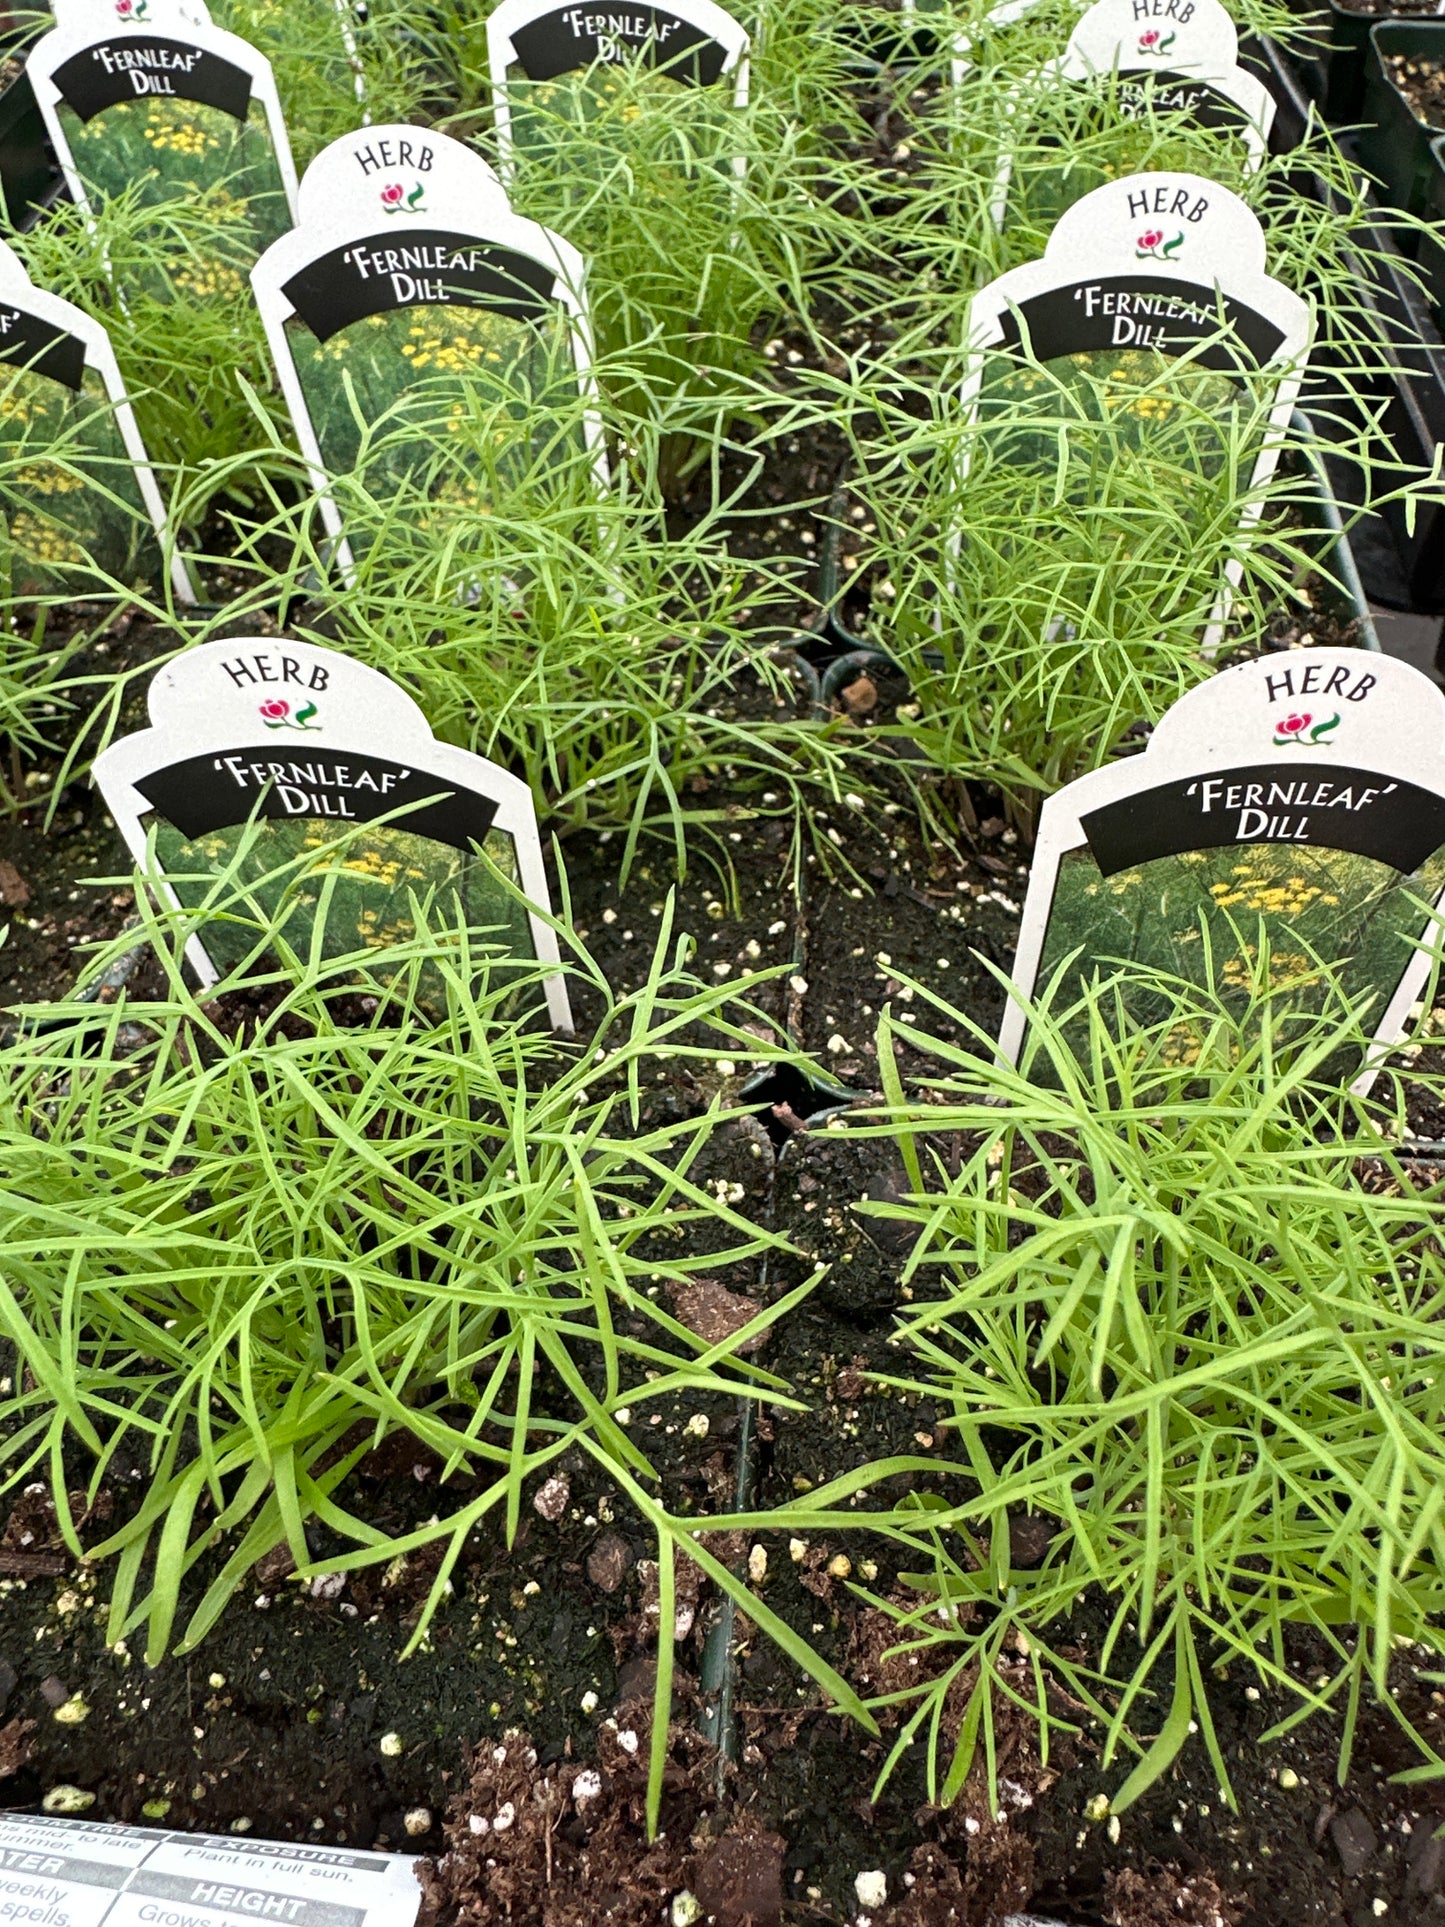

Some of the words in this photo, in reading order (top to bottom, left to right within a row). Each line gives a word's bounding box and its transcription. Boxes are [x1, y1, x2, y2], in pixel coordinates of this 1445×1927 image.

[1132, 0, 1195, 24] HERB
[93, 47, 202, 74] 'FERNLEAF'
[129, 70, 176, 95] DILL
[354, 140, 434, 176] HERB
[1127, 187, 1209, 223] HERB
[344, 246, 490, 279] 'FERNLEAF'
[390, 272, 450, 302] DILL
[1111, 315, 1168, 349] DILL
[220, 655, 330, 691] HERB
[1265, 665, 1377, 703] HERB
[214, 756, 411, 794] 'FERNLEAF'
[276, 785, 356, 817] DILL
[1186, 778, 1398, 812] 'FERNLEAF'
[1235, 808, 1310, 840] DILL
[79, 1823, 143, 1837] TIME
[79, 1834, 98, 1844] to
[102, 1837, 142, 1850] late
[183, 1848, 241, 1865] Plant
[246, 1857, 265, 1868] in
[272, 1861, 304, 1874] full
[309, 1867, 353, 1883] sun.
[204, 1838, 356, 1867] EXPOSURE
[191, 1882, 307, 1919] HEIGHT
